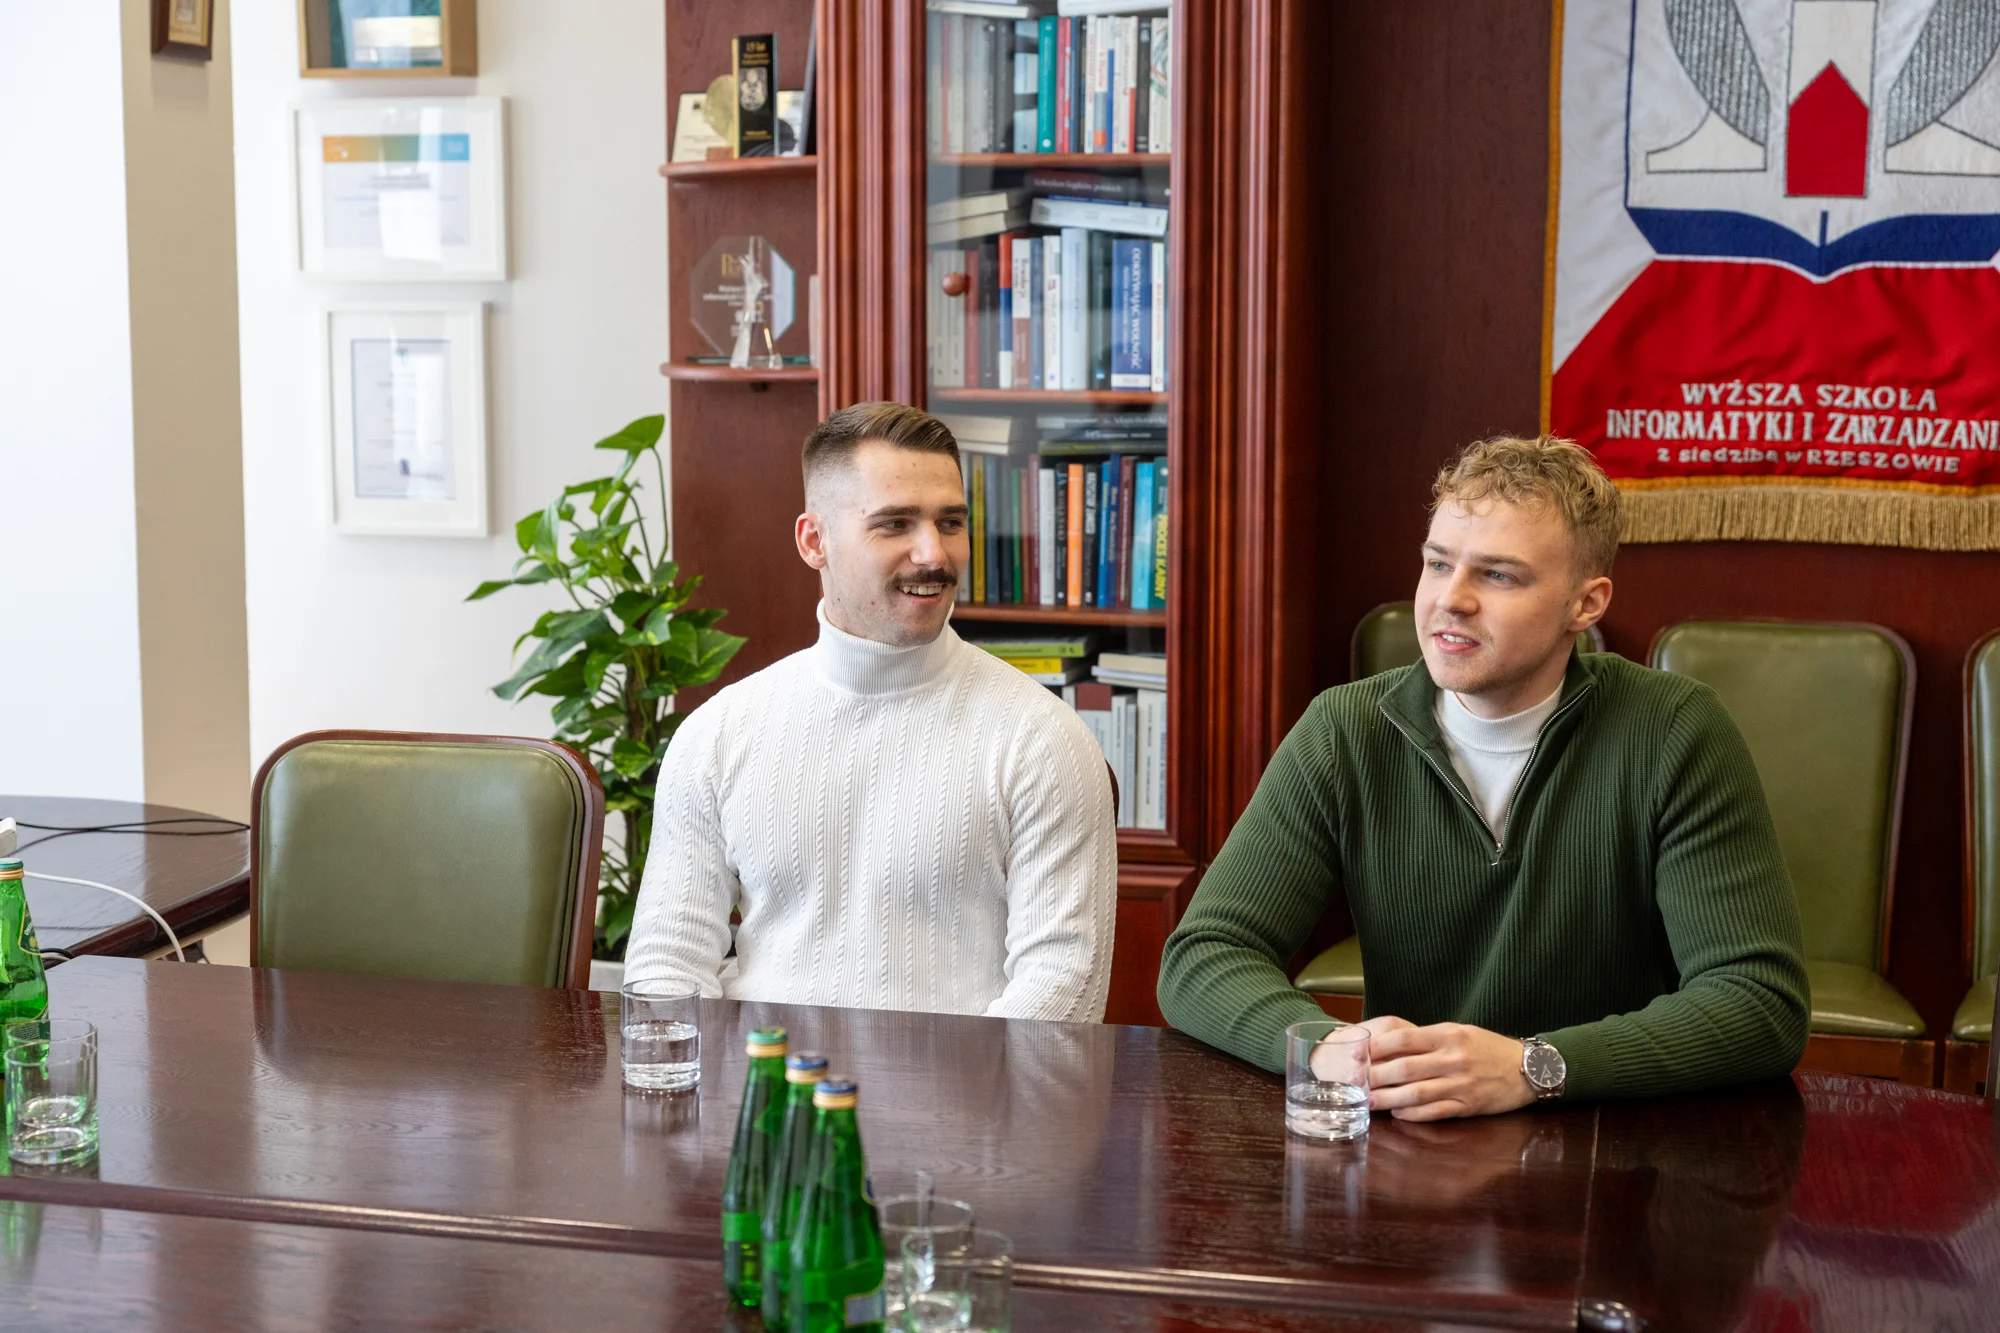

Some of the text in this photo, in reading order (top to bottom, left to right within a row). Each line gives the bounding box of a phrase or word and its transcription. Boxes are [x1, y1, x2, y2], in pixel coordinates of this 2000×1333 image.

[1681, 379, 1937, 412] WYŻSZA SZKOŁA
[1606, 409, 2000, 451] INFORMATYKI I ZARZĄDZANI
[1785, 451, 1802, 463] w
[1807, 449, 1960, 473] RZESZOWIE
